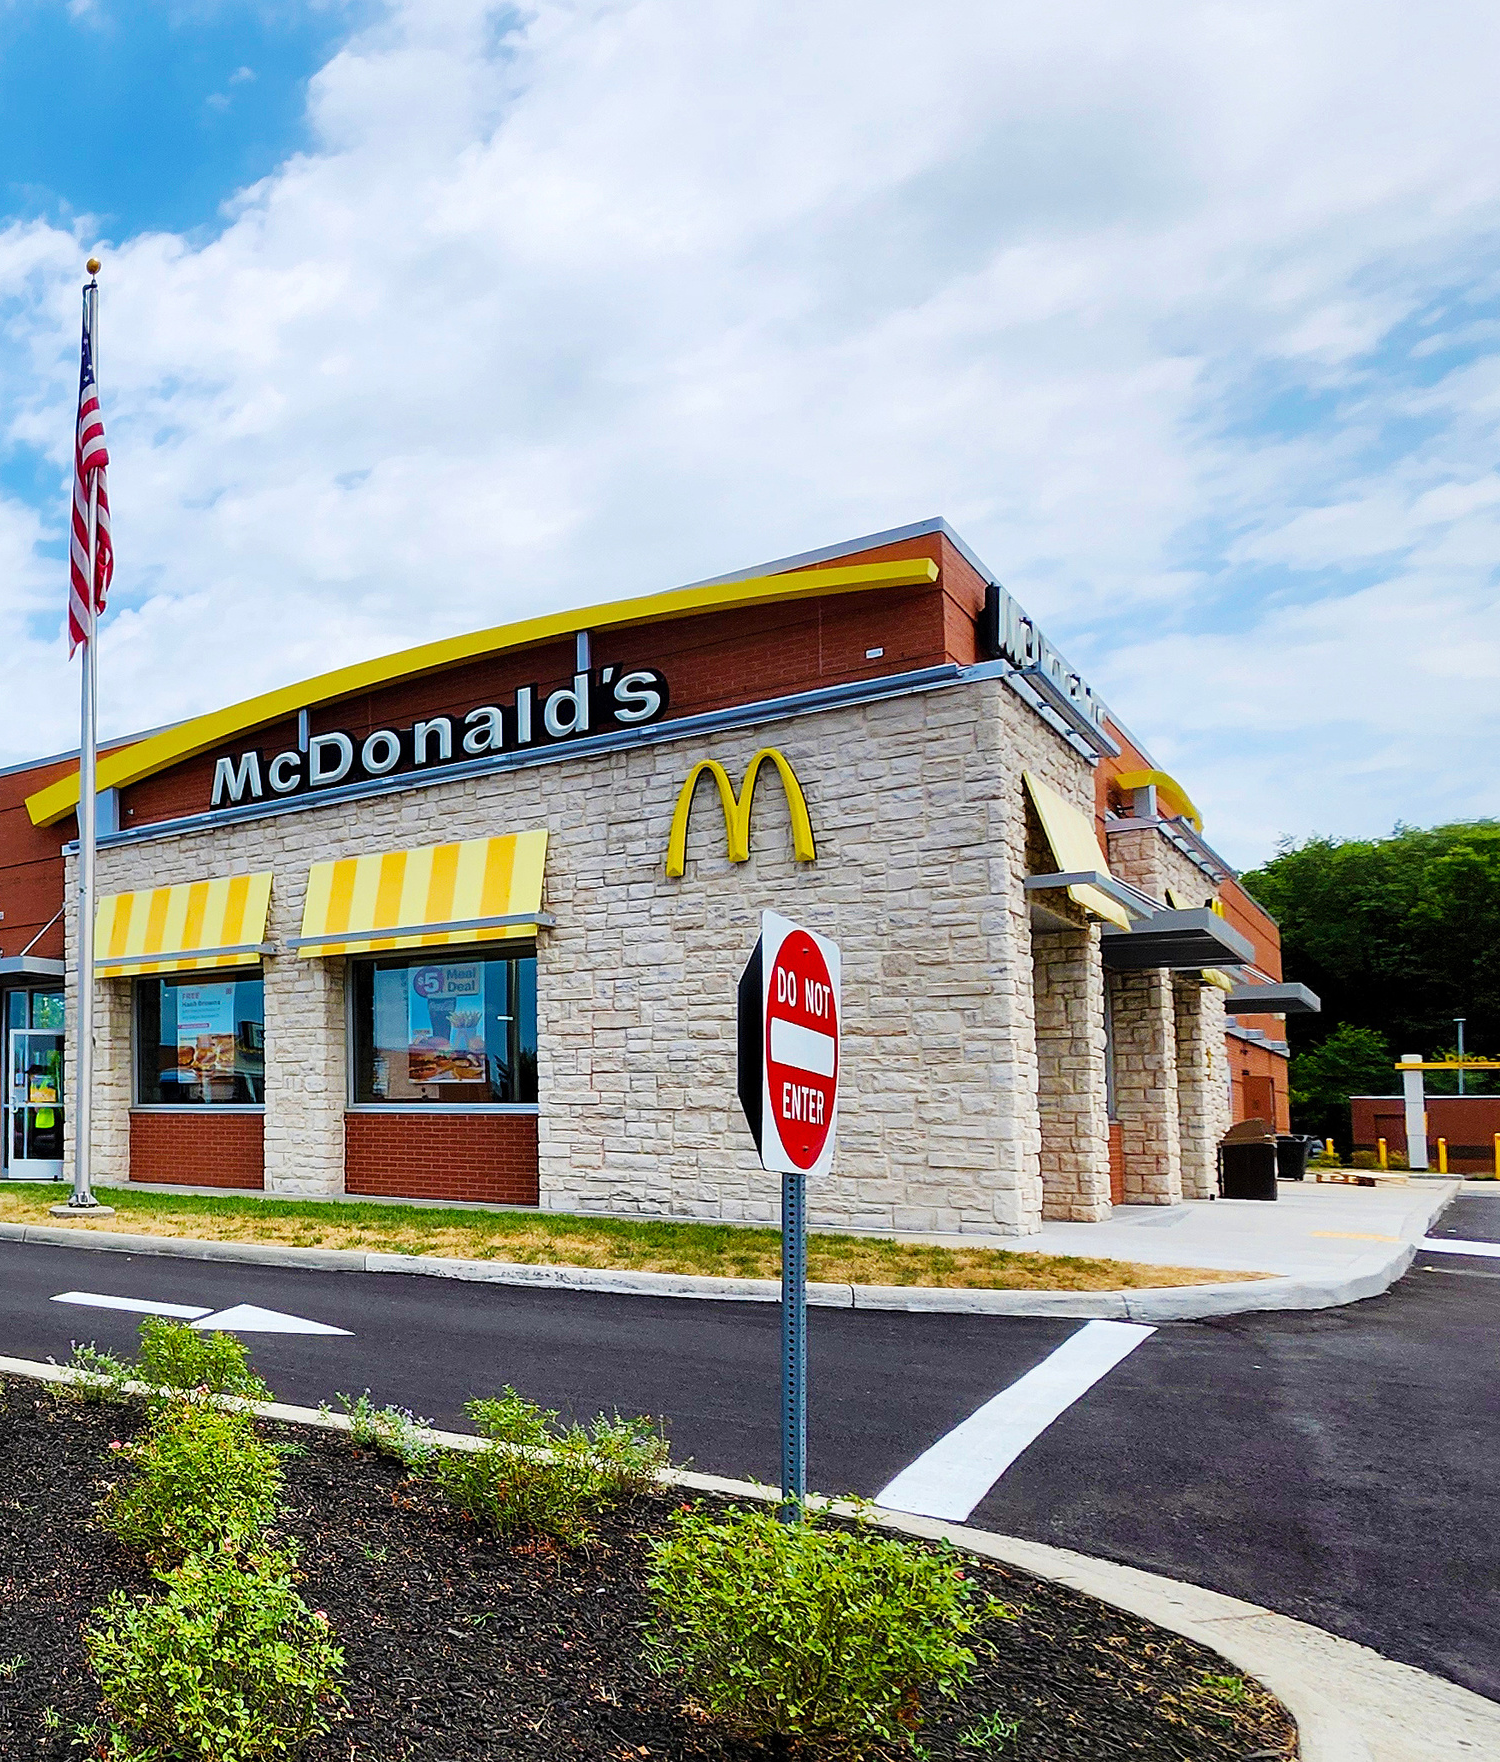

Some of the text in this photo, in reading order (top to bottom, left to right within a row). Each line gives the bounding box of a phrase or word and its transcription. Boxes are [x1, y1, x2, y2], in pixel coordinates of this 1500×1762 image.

[210, 667, 663, 806] McDonald's
[666, 747, 817, 877] M
[417, 972, 440, 993] $5
[446, 966, 476, 980] Meal
[447, 981, 475, 993] Deal
[182, 992, 200, 1000] FREE
[777, 966, 830, 1019] DO NOT
[782, 1081, 824, 1126] ENTER
